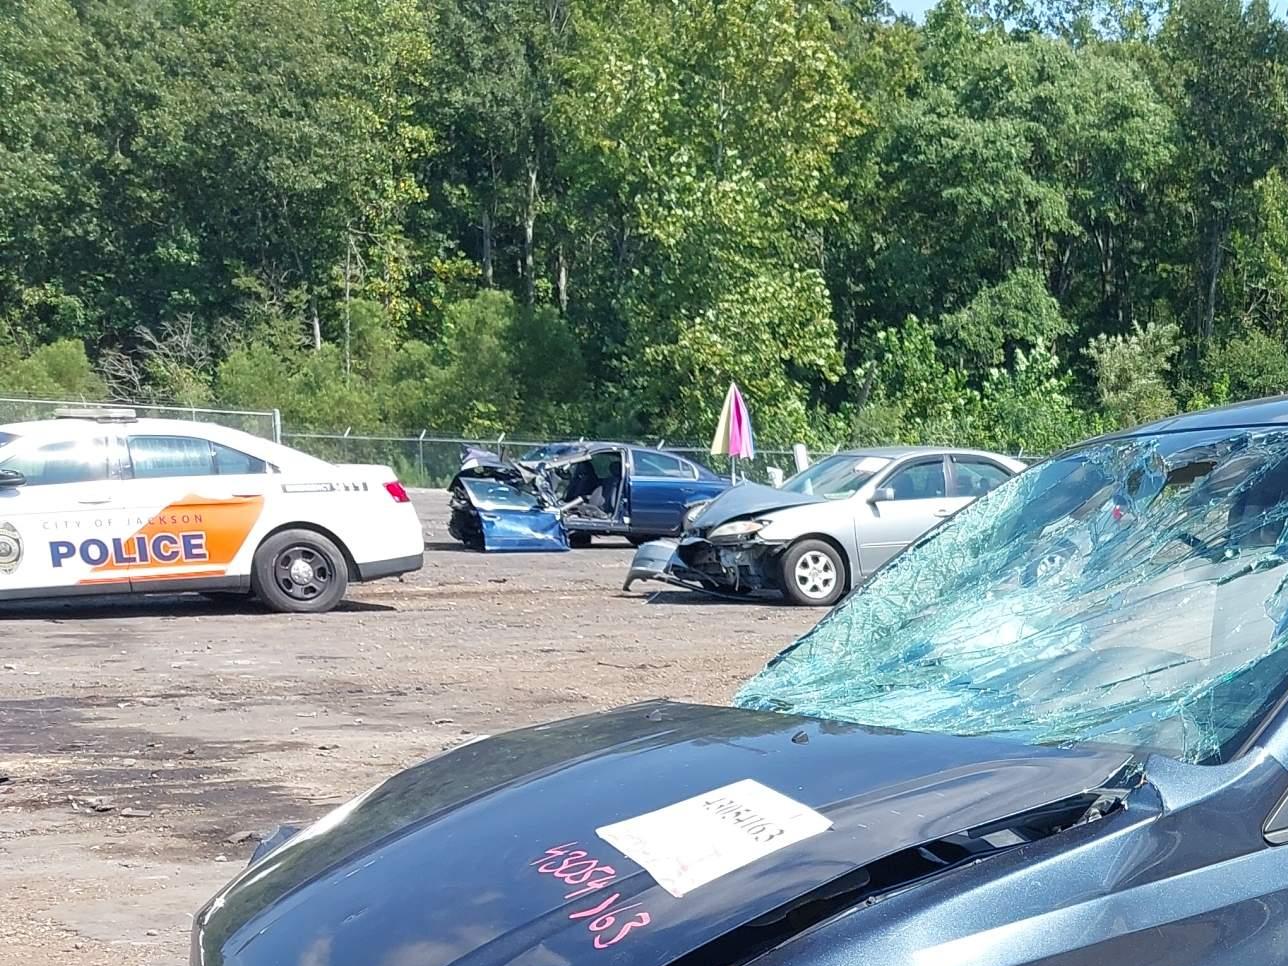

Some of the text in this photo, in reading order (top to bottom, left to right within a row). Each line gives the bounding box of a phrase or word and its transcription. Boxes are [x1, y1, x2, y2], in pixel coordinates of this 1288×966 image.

[42, 514, 203, 530] CITY OF JACKSON
[48, 533, 208, 568] POLICE
